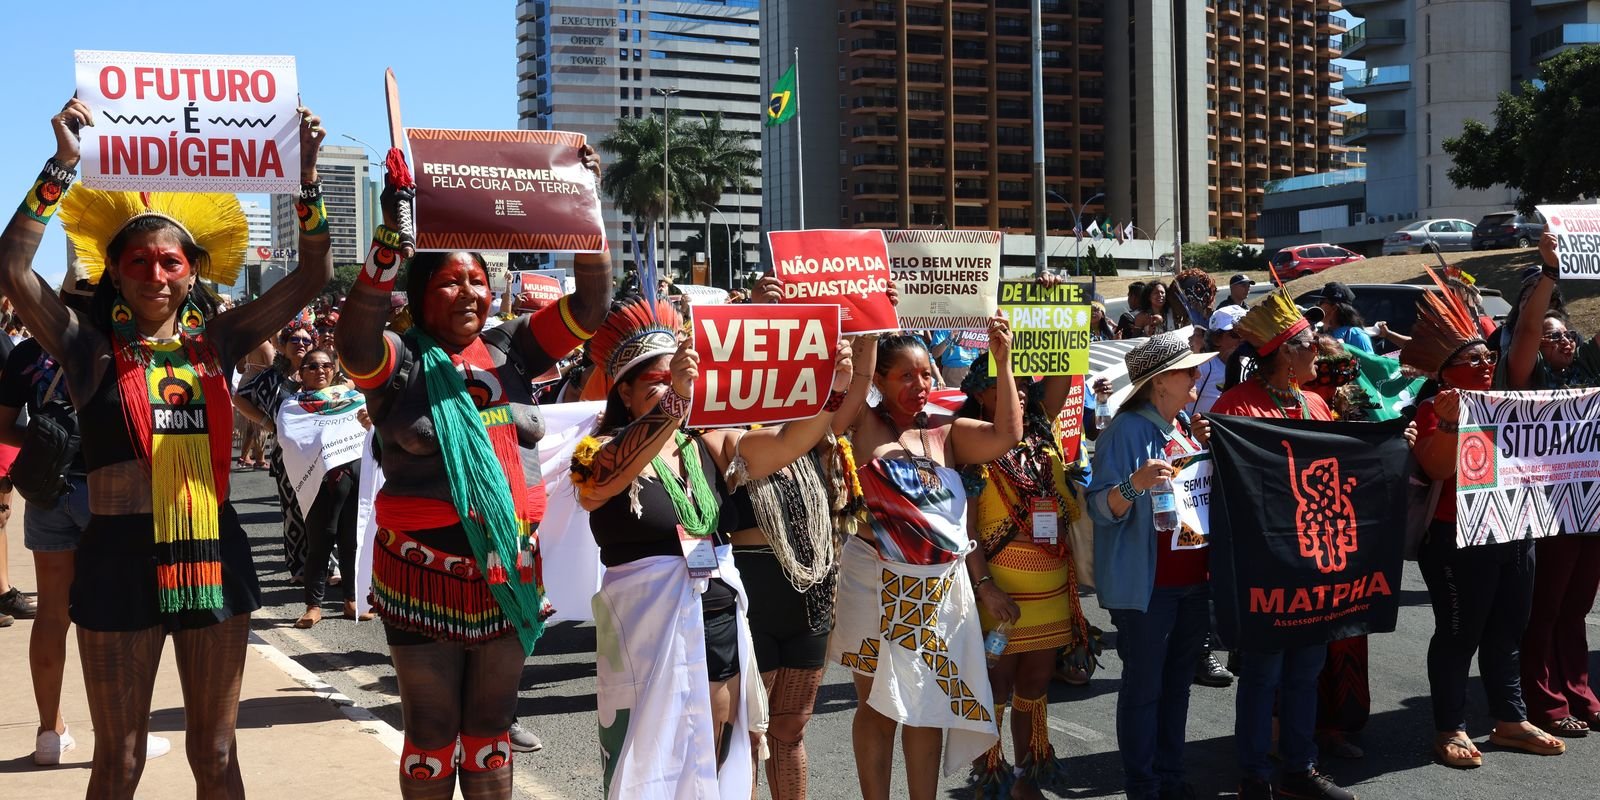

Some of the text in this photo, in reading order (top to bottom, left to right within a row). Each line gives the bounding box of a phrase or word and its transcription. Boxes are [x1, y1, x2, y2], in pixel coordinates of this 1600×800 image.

[561, 16, 617, 27] EXECUTIVE
[570, 35, 604, 46] OFFICE
[570, 55, 607, 66] TOWER
[99, 65, 276, 103] O FUTURO
[184, 102, 200, 134] É
[99, 131, 285, 178] INDÍGENA
[432, 176, 581, 195] PELA CURA DA TERRA
[1558, 233, 1570, 253] A
[272, 248, 297, 259] GEAP
[922, 257, 952, 269] BEM
[955, 257, 992, 269] VIVER
[781, 255, 886, 275] NÃO AO PL DA
[921, 270, 989, 282] MULHERES
[784, 274, 888, 299] DEVASTAÇÃO
[904, 280, 978, 295] INDÍGENAS
[1026, 284, 1083, 302] LIMITE:
[1013, 307, 1073, 329] PARE OS
[701, 319, 829, 362] VETA
[1011, 329, 1088, 350] MBUSTÍVEIS
[1011, 350, 1070, 373] FÓSSEIS
[703, 367, 818, 412] LULA
[154, 409, 204, 429] RAONI
[480, 408, 508, 426] ONI
[1184, 477, 1202, 492] SEM
[1249, 571, 1392, 614] MATPHA
